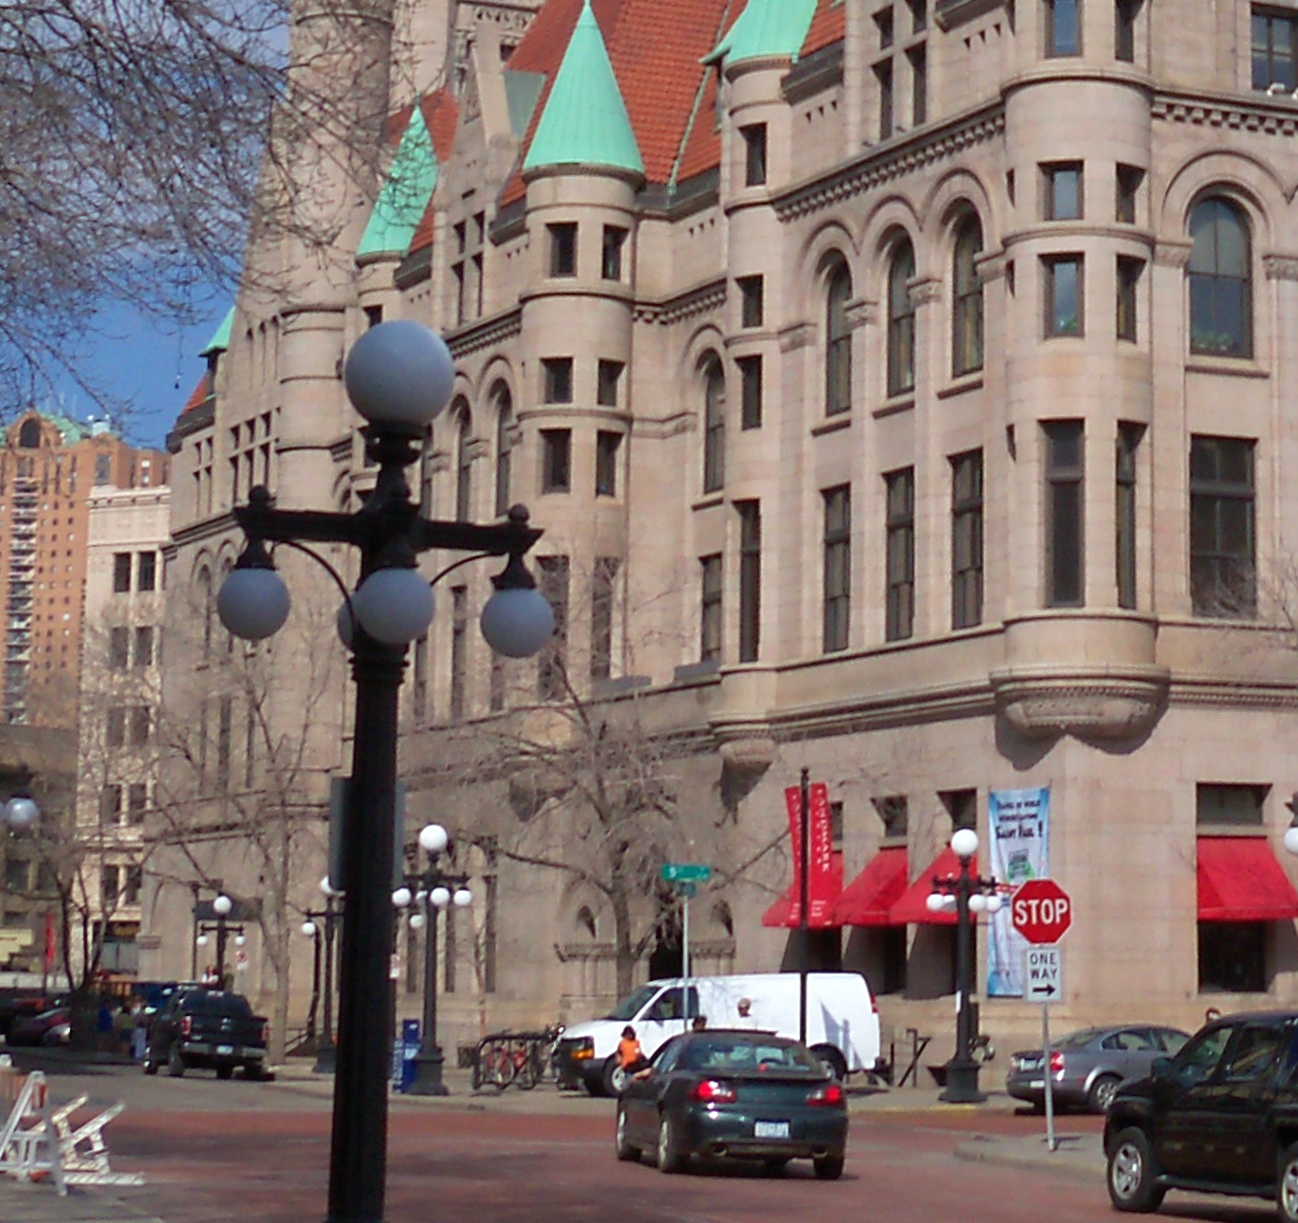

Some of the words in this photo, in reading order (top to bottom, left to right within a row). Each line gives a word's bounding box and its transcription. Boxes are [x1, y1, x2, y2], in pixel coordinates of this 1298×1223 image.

[1014, 898, 1069, 926] STOP
[1029, 951, 1057, 966] ONE
[1030, 968, 1058, 980] WAY
